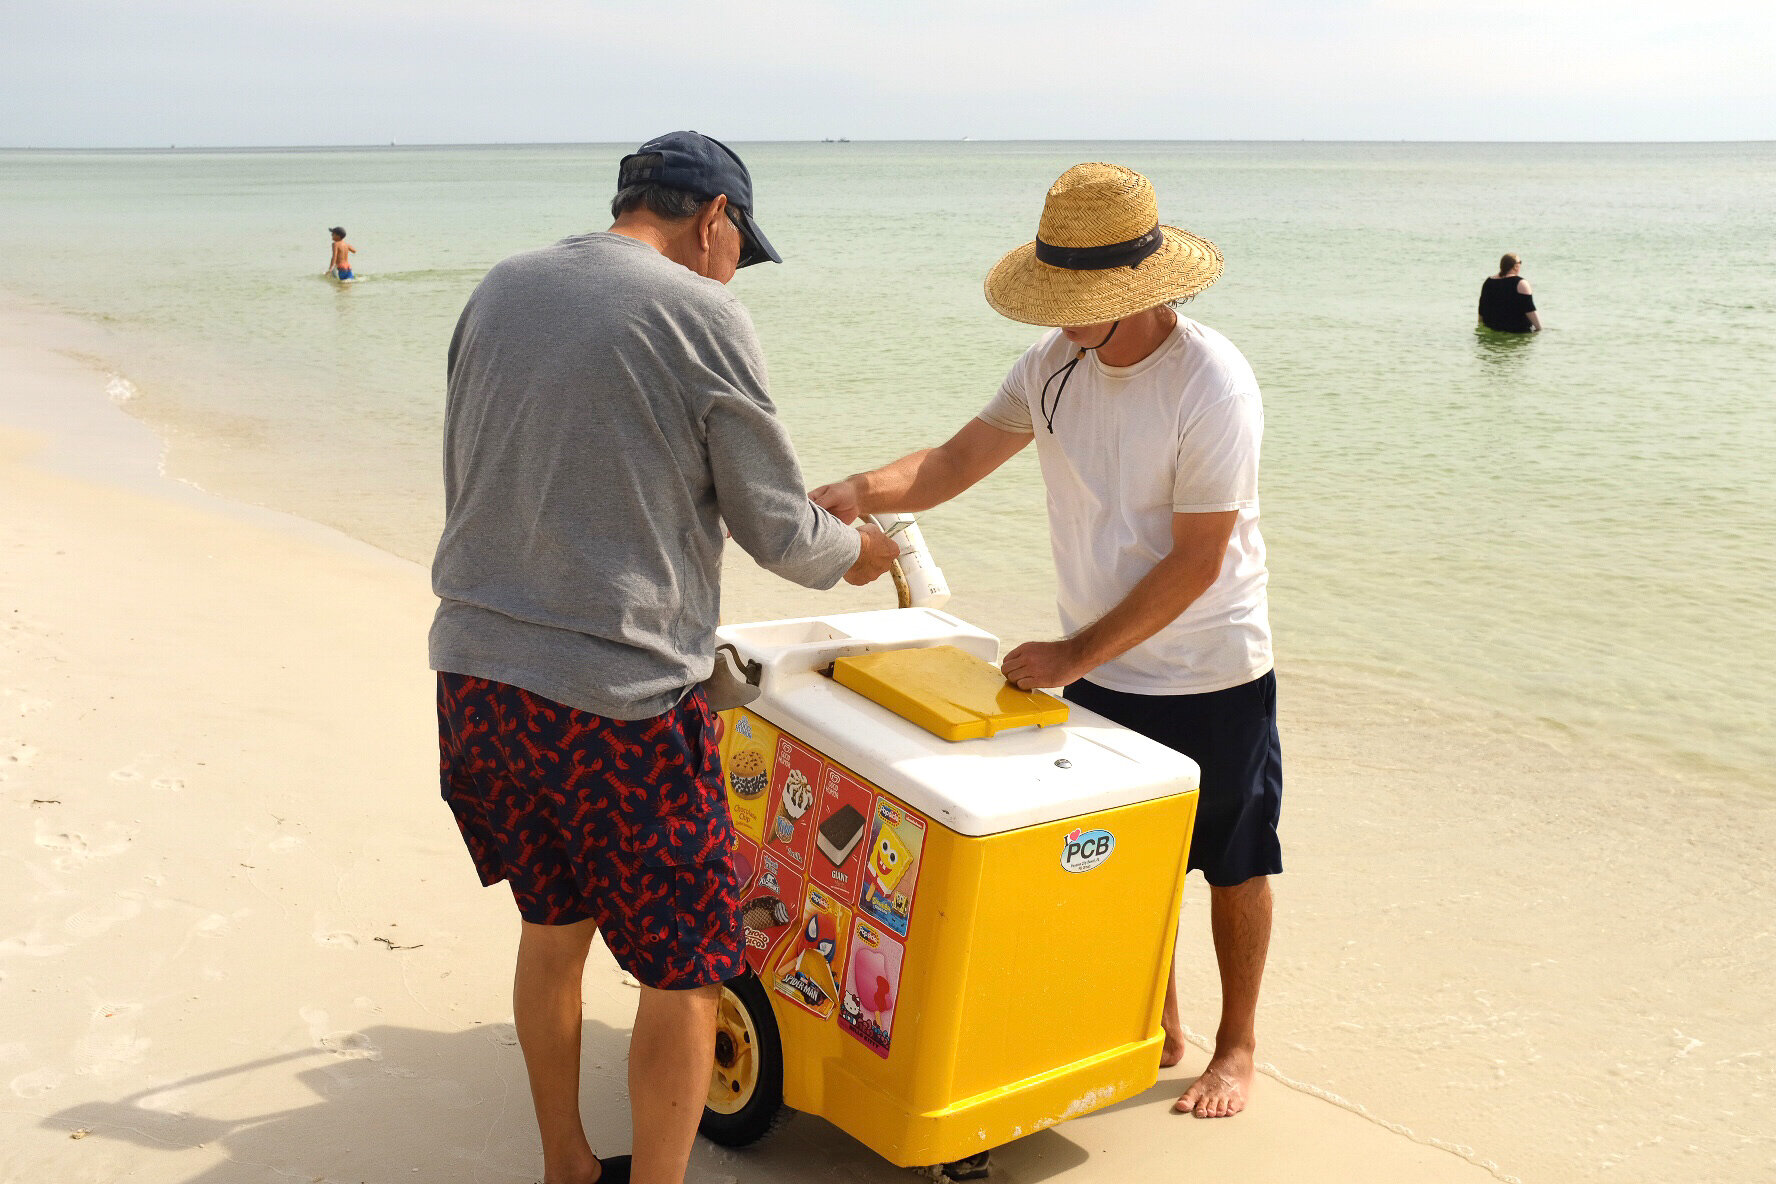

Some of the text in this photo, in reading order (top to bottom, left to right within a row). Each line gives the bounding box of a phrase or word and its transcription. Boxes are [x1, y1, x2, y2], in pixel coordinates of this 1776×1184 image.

[1064, 835, 1069, 846] I
[1067, 836, 1110, 863] PCB
[831, 870, 849, 883] GIANT
[744, 927, 768, 942] CHOCO
[863, 1035, 879, 1048] KITTY
